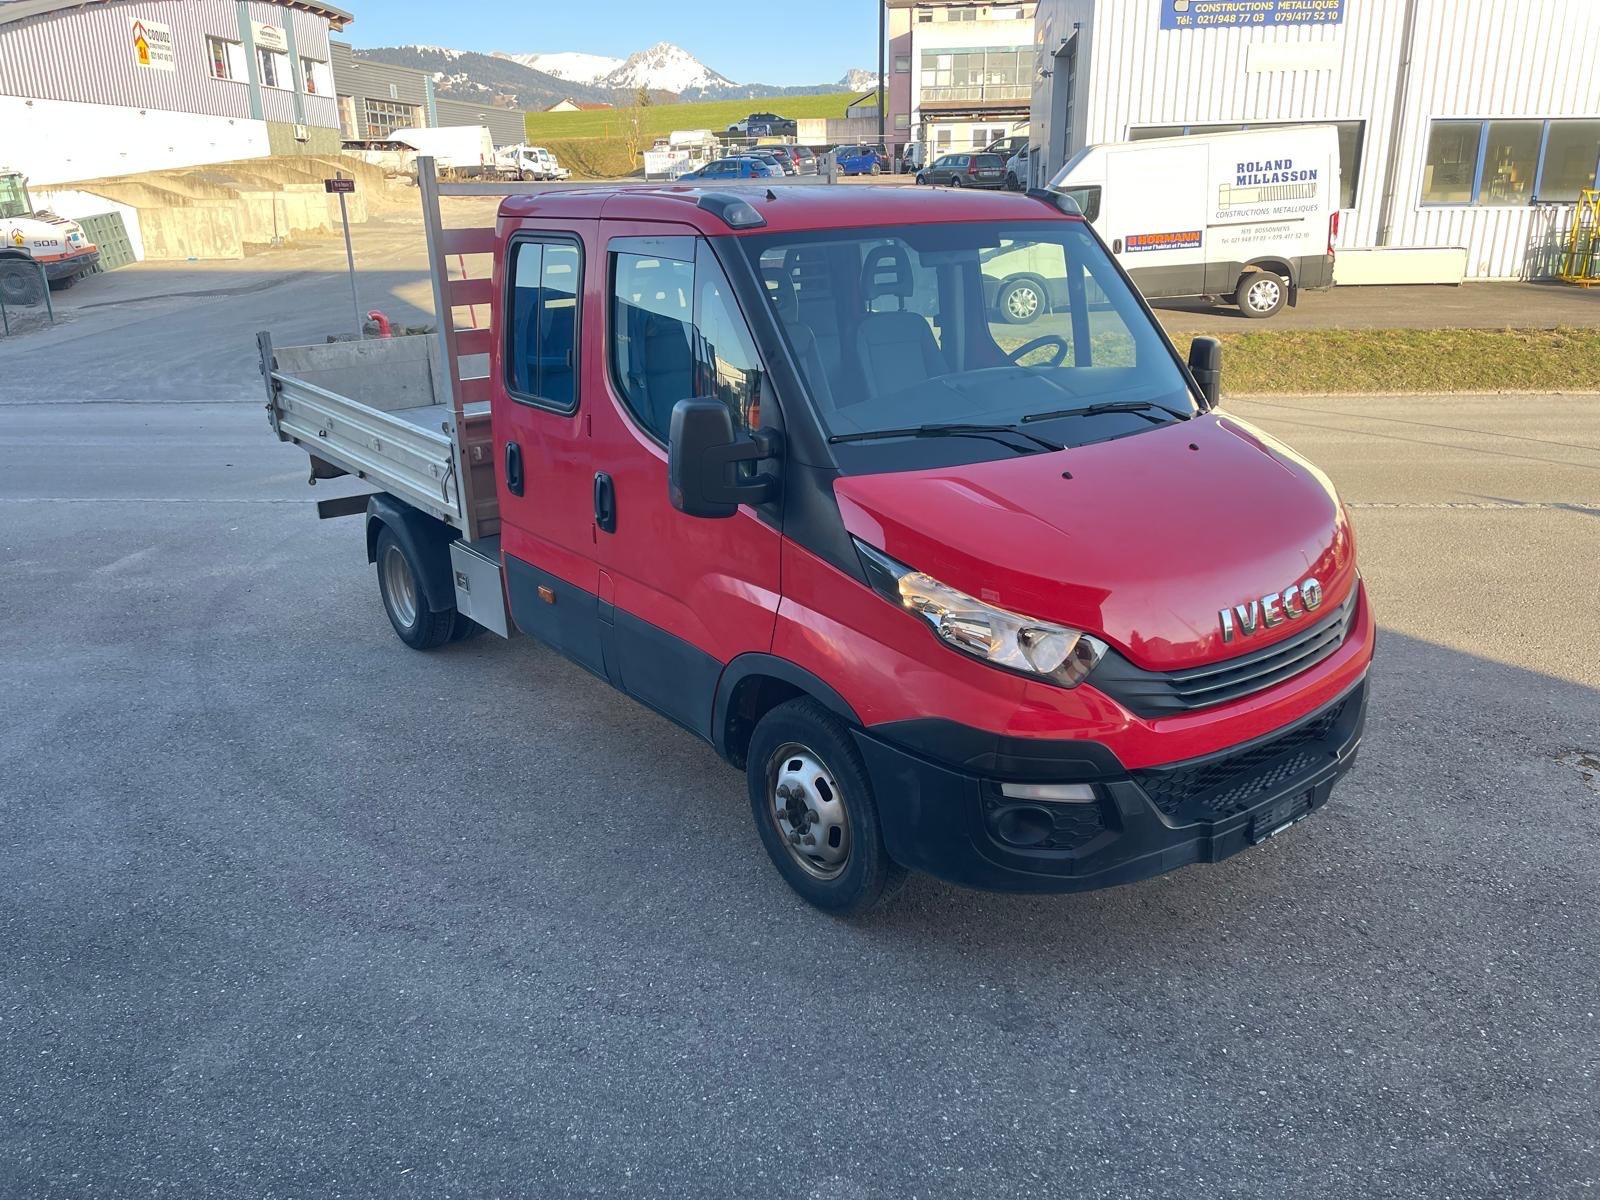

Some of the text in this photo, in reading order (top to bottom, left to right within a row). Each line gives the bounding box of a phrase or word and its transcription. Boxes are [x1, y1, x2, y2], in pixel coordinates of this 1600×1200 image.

[1195, 0, 1339, 13] CONSTRUCTIONS METALLIQUES
[1197, 14, 1236, 24] 021/948
[1239, 13, 1251, 22] 77
[1253, 13, 1265, 22] 03
[1274, 11, 1312, 21] 079/417
[1313, 11, 1326, 20] 52
[1328, 11, 1338, 20] 10
[1236, 159, 1292, 174] ROLAND
[1236, 169, 1318, 186] MILLASSON
[1215, 204, 1318, 219] CONSTRUCTIONS METALLIQUES
[33, 239, 58, 247] 509
[1218, 577, 1322, 643] IVECO
